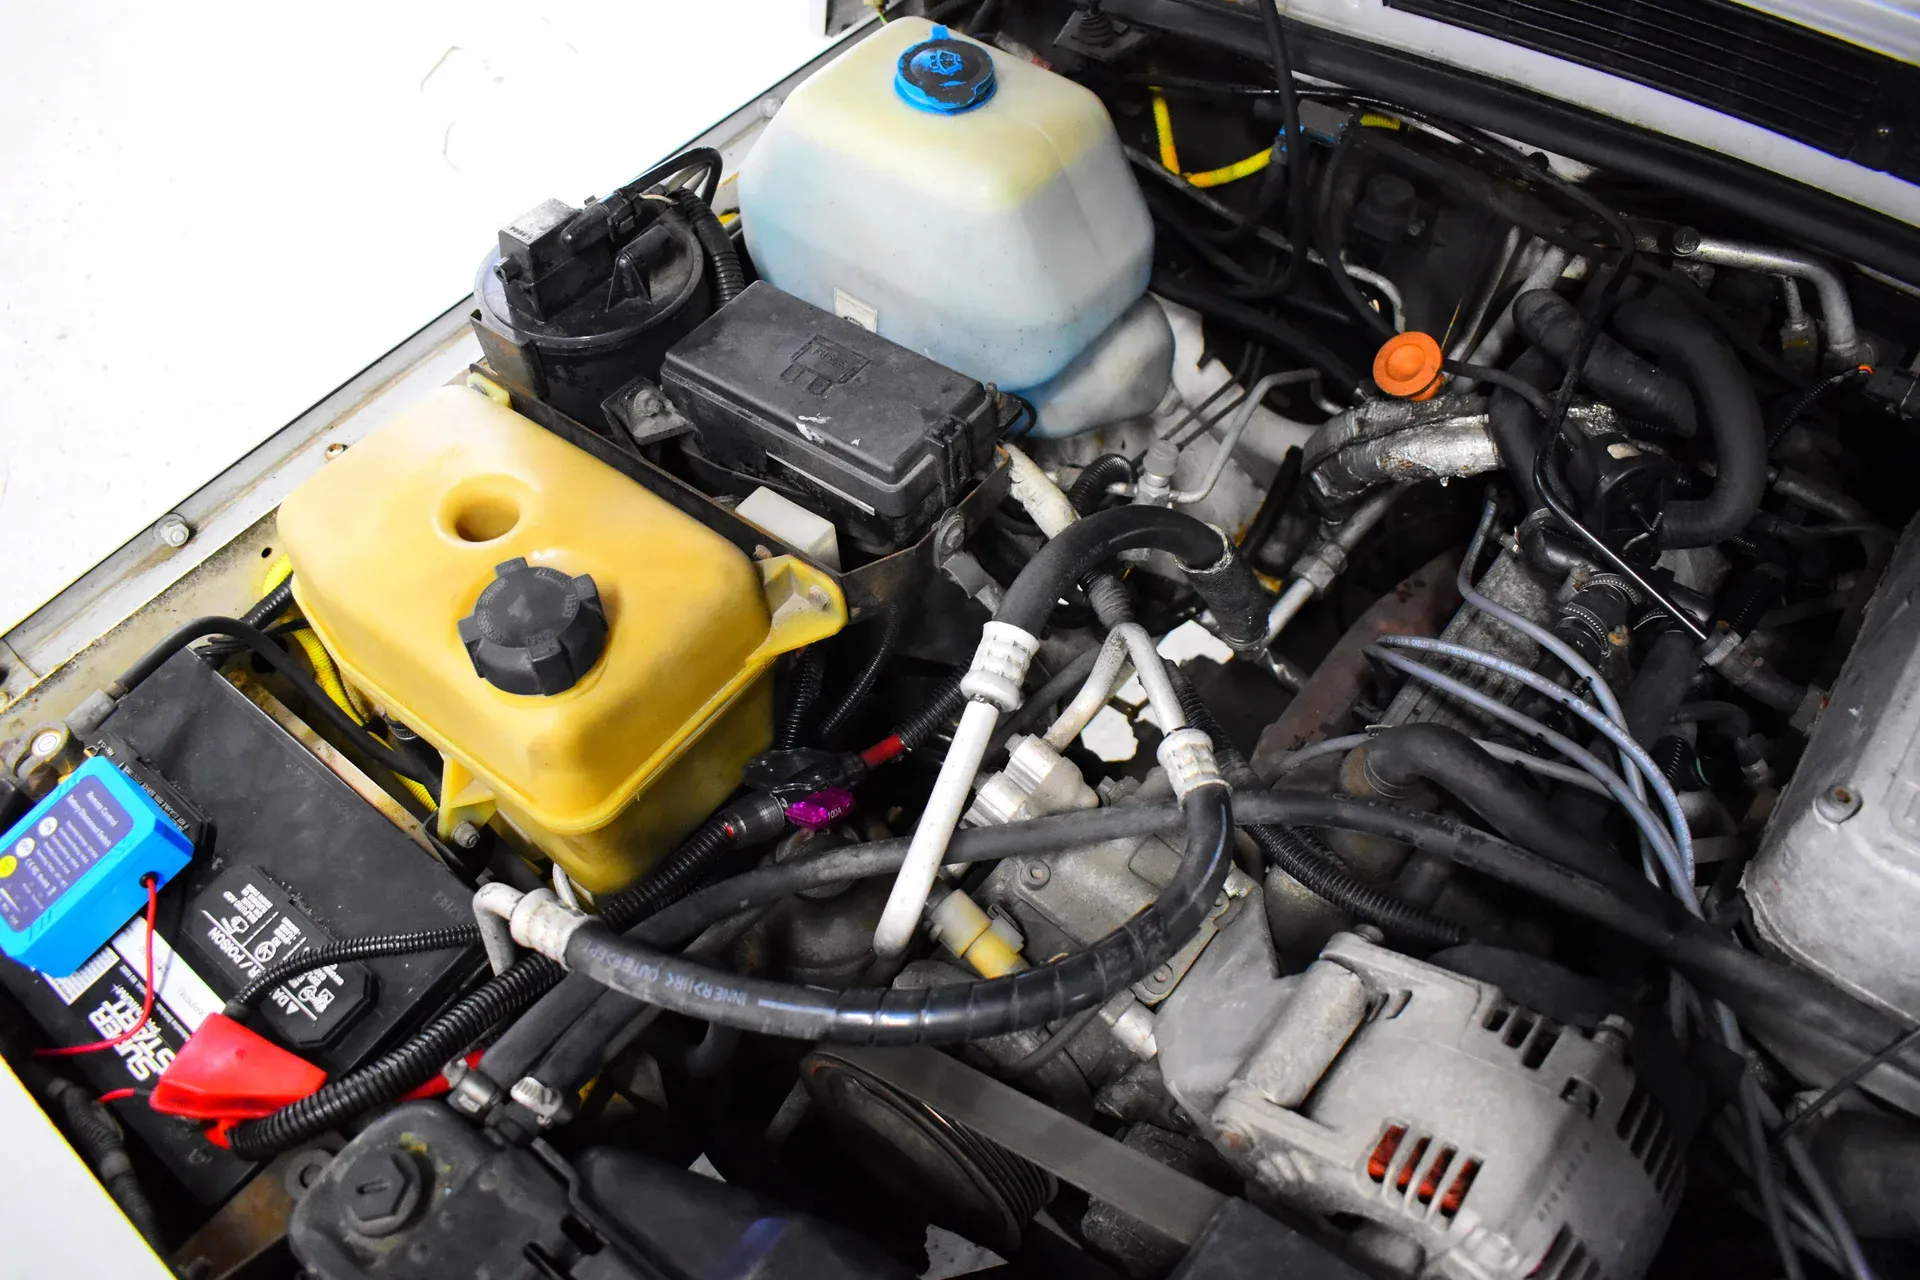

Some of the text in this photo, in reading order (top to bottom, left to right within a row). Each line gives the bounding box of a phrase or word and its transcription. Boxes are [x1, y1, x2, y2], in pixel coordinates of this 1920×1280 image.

[99, 806, 119, 827] Control
[827, 806, 843, 820] 100A
[207, 926, 245, 964] POISON
[88, 1007, 150, 1081] SUPER
